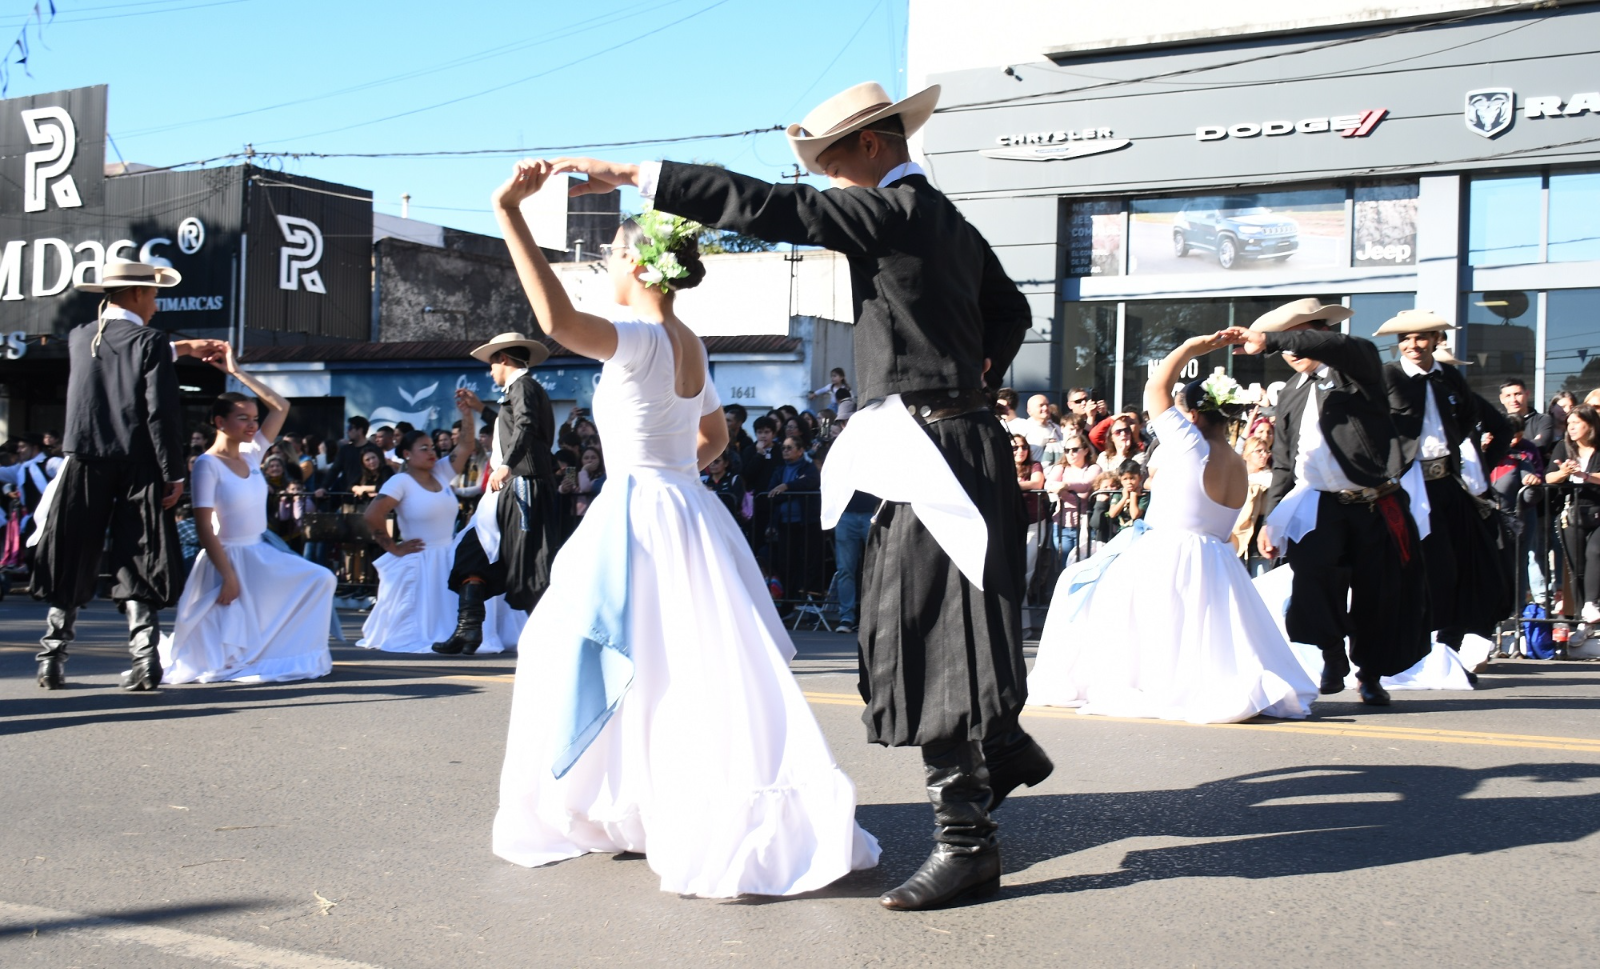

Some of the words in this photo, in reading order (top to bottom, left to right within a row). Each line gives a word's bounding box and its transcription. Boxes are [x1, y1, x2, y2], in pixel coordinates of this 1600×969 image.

[1524, 92, 1600, 118] RA
[995, 127, 1112, 146] CHRYSLER
[1195, 114, 1362, 140] DODGE
[1356, 241, 1411, 263] Jeep
[731, 386, 756, 399] 1641
